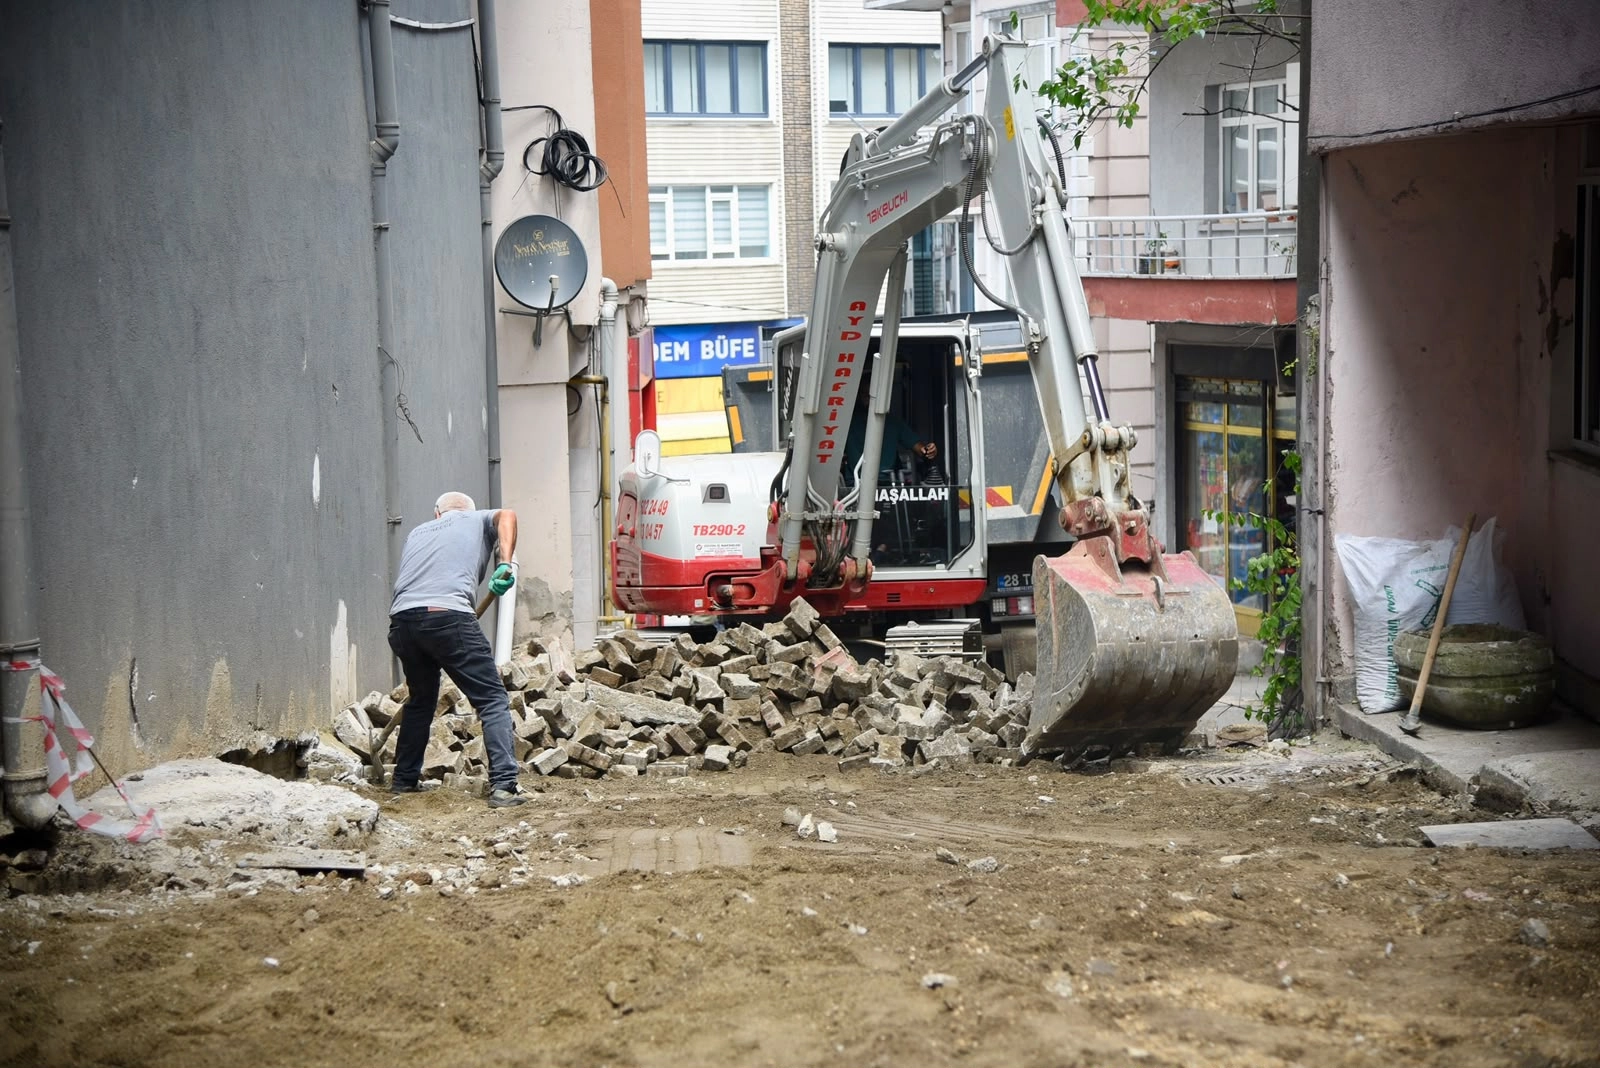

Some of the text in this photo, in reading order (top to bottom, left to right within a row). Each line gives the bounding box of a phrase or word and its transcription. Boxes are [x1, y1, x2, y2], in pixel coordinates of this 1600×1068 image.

[866, 189, 909, 225] TAKEUCHI
[700, 334, 756, 360] BÜFE
[816, 353, 855, 463] HAFRİYAT
[657, 499, 669, 516] 49
[653, 523, 664, 540] 57
[692, 524, 746, 536] TB290-2
[1003, 574, 1020, 587] 28
